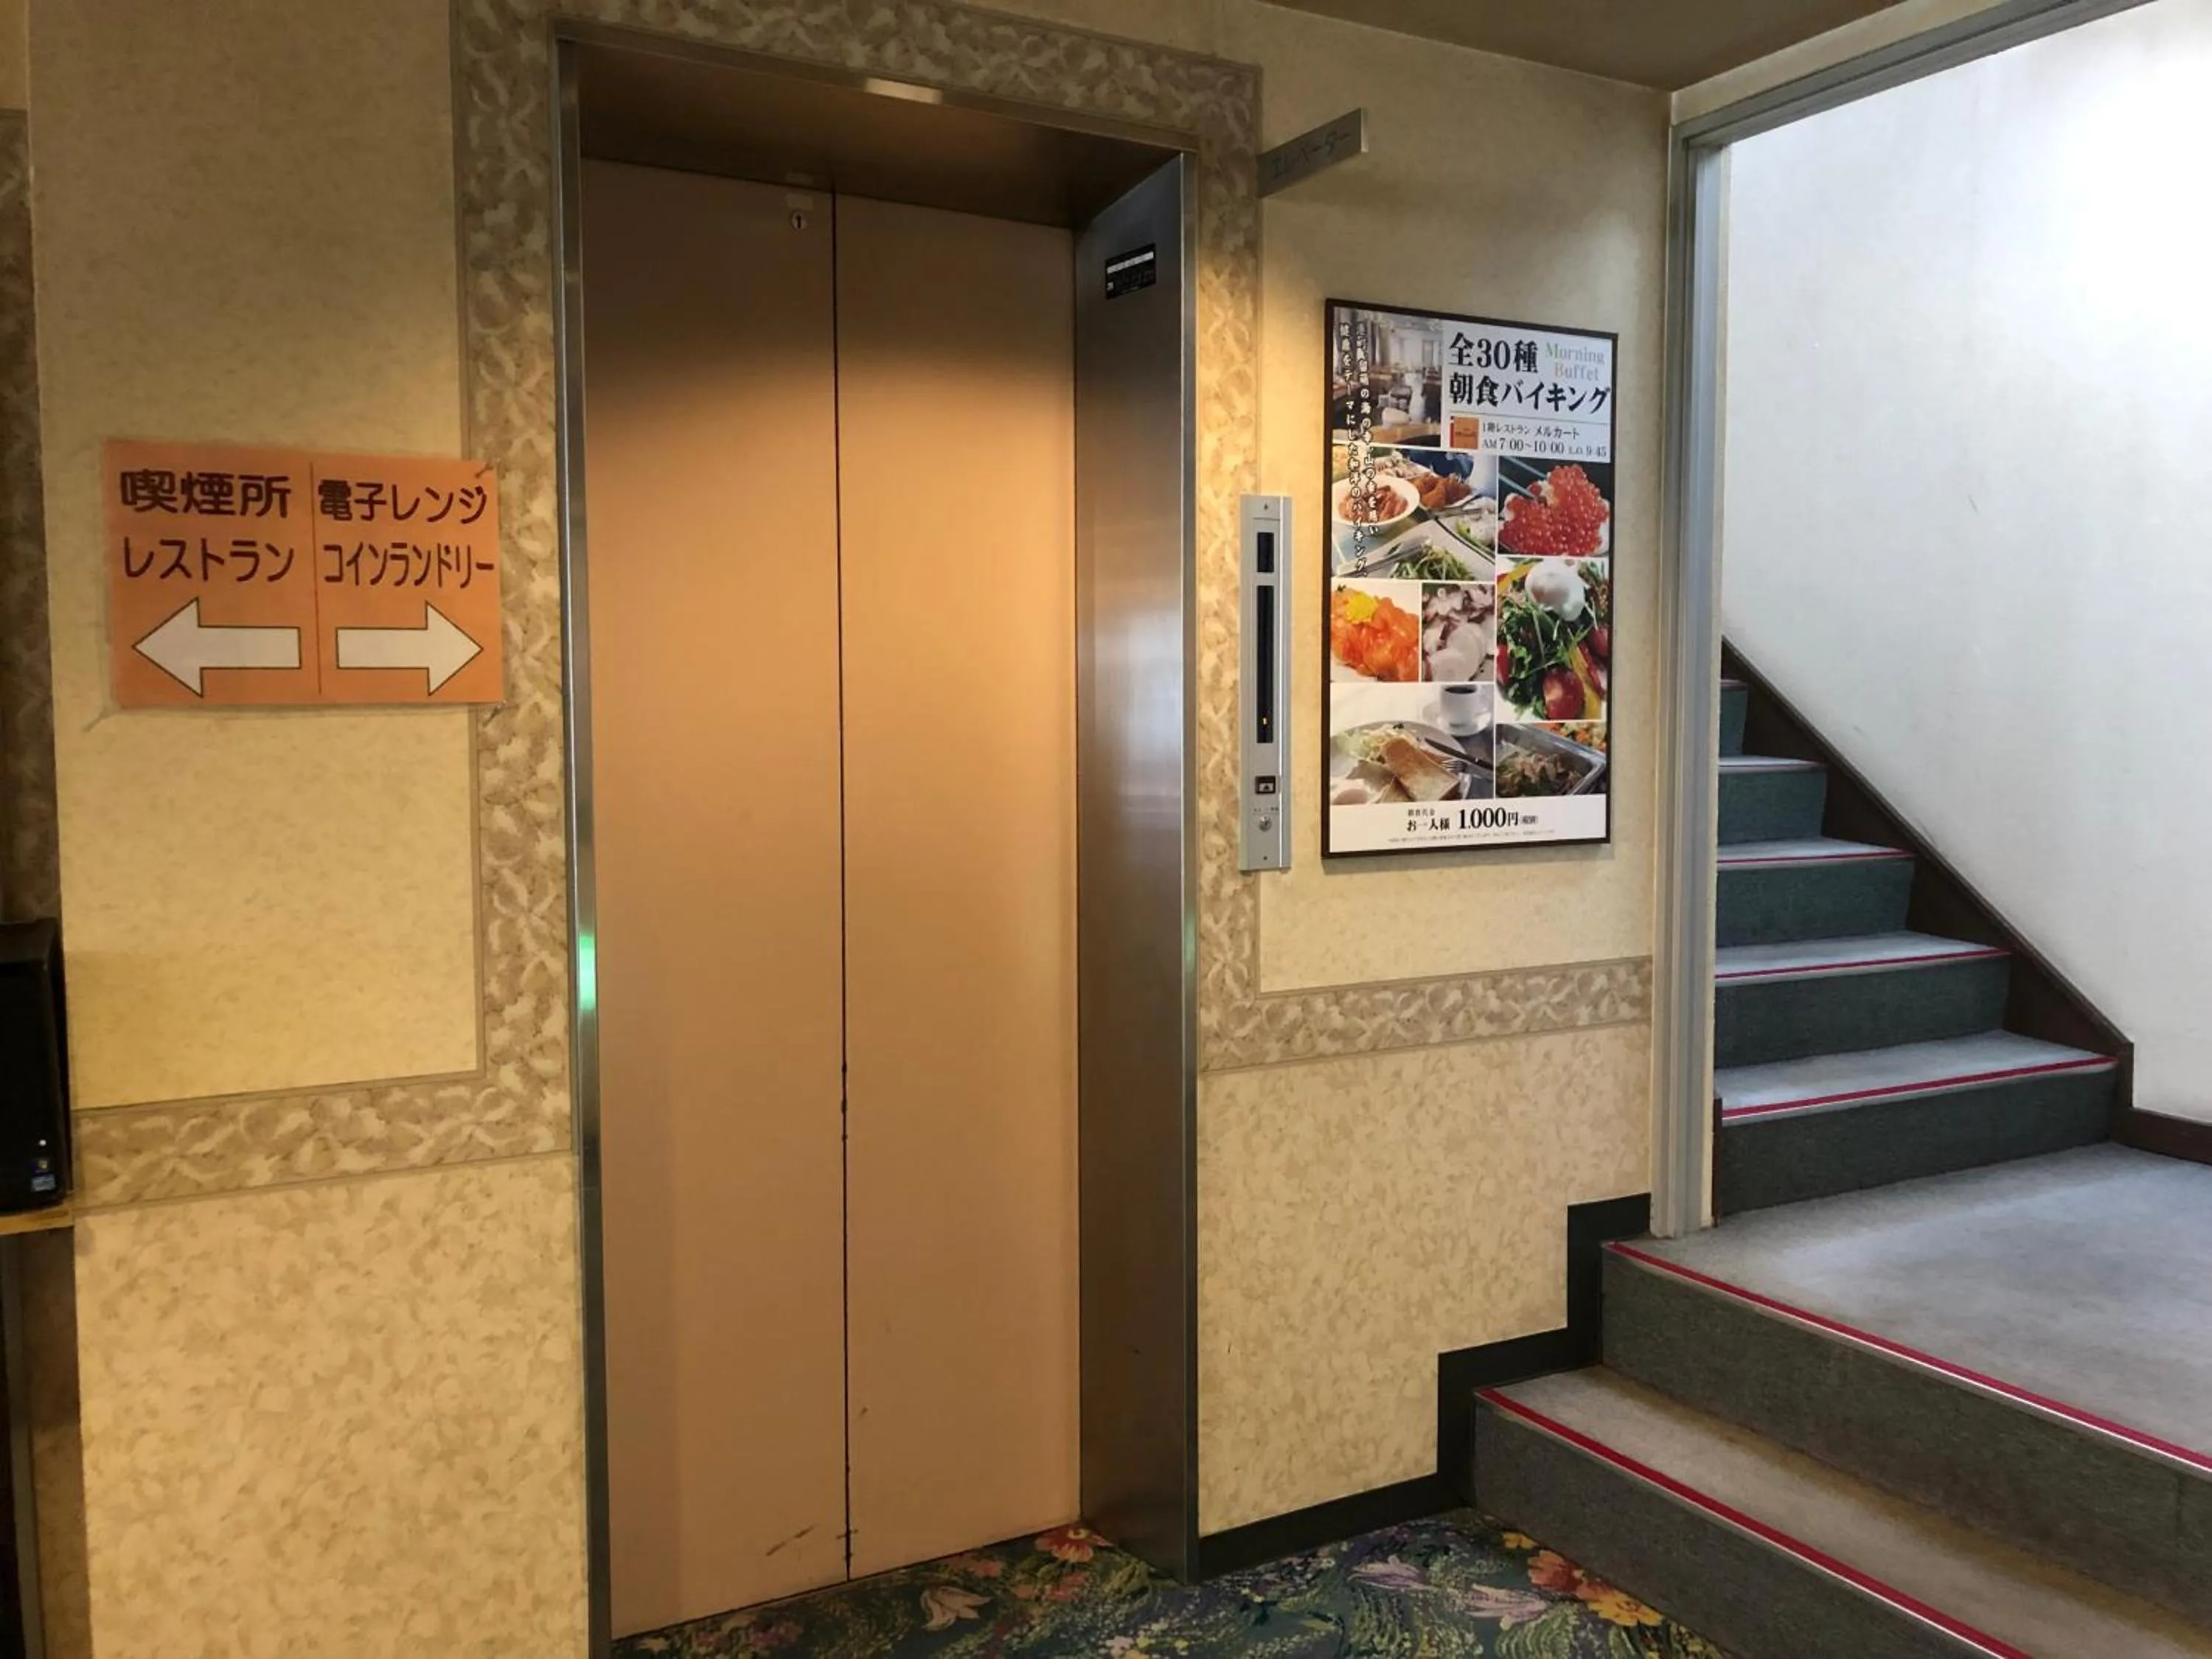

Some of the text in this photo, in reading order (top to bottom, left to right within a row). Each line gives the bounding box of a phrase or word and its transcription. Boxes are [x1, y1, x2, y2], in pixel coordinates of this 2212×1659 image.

[1448, 332, 1538, 373] 全30種
[1545, 342, 1605, 365] Morning
[1554, 362, 1599, 381] Buffet
[1450, 372, 1610, 414] 朝食バイキング
[1483, 422, 1530, 435] 1階レストラン
[1534, 424, 1580, 440] メルカート
[120, 468, 291, 518] 喫煙所
[319, 479, 487, 524] 電子レンジ
[124, 537, 294, 582] レストラン
[324, 541, 494, 589] コインランドリー
[1407, 817, 1450, 832] お一人様
